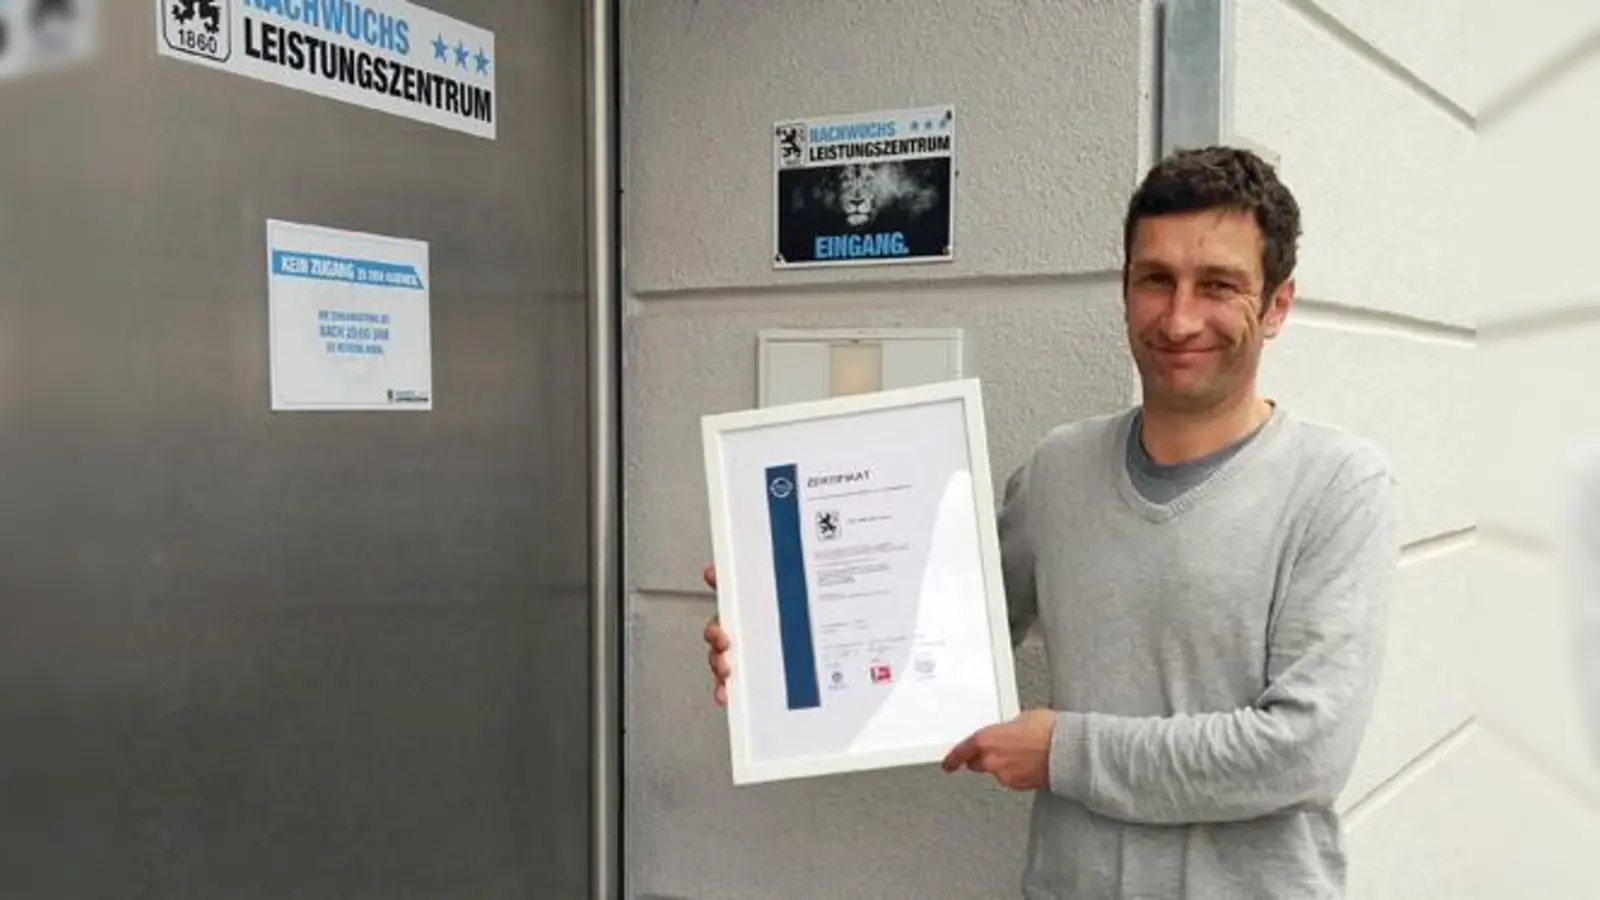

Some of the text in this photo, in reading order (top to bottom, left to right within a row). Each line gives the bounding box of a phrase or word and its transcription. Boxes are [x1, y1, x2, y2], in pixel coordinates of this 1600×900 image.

[178, 28, 218, 54] 1860
[243, 0, 411, 55] CHWUCHS
[243, 16, 493, 123] LEISTUNGSZENTRUM
[809, 120, 897, 143] NACHWUCHS
[809, 135, 951, 162] LEISTUNGSZENTRUM
[814, 231, 910, 259] EINGANG.
[280, 255, 308, 273] KEIN
[310, 258, 355, 281] ZUGANG
